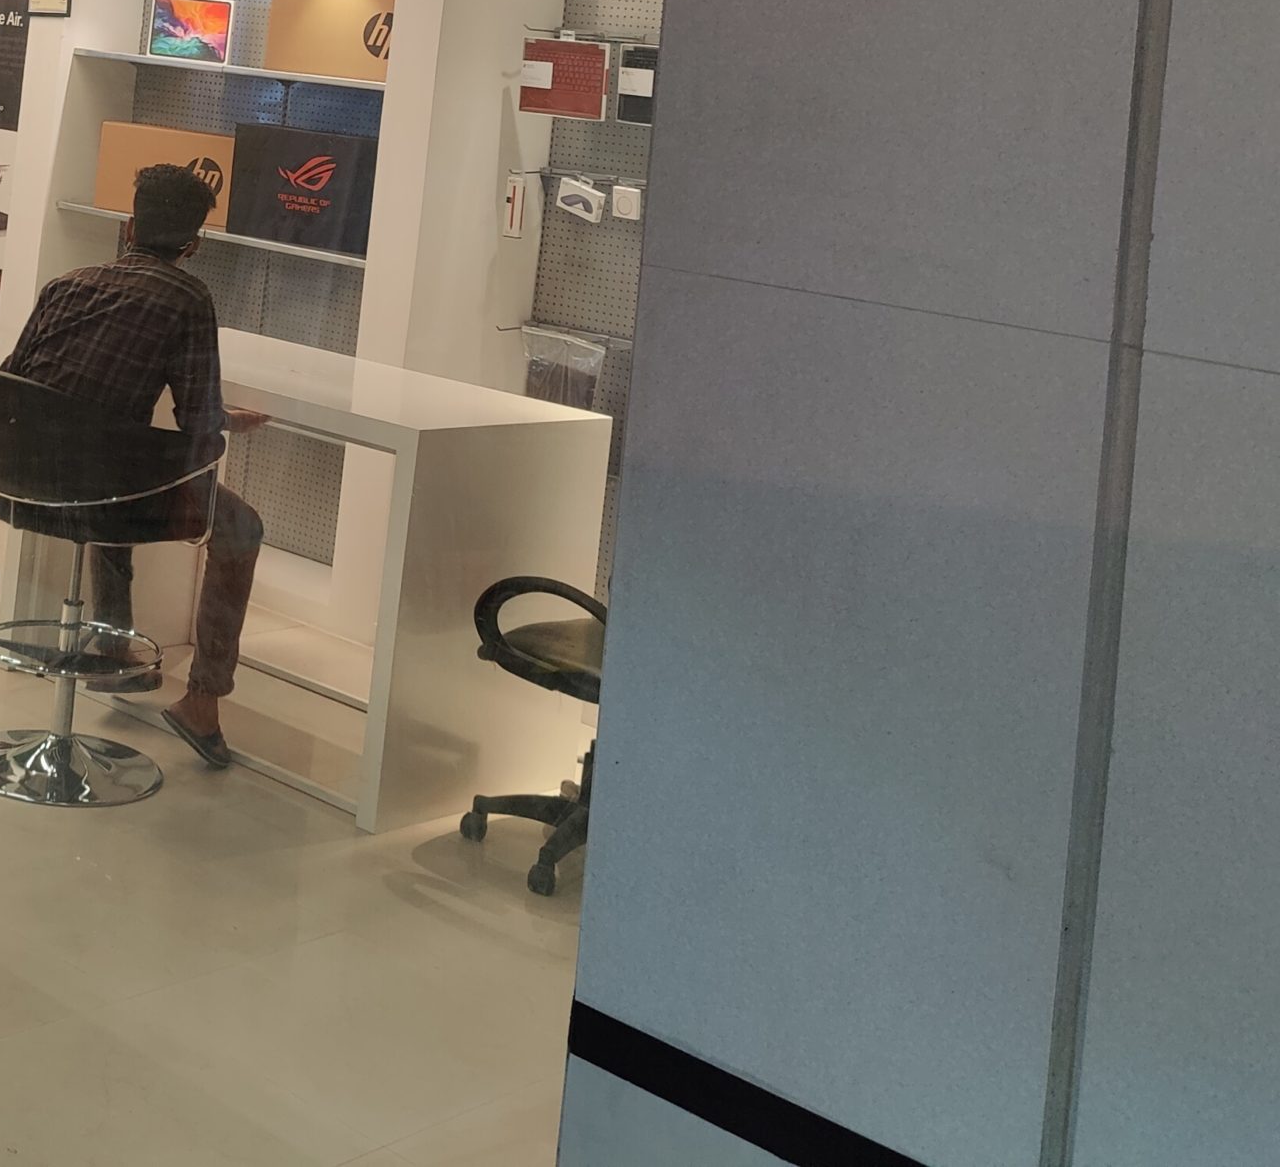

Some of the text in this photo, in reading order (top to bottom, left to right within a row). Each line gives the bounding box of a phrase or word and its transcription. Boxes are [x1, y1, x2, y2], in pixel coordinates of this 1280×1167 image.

[6, 11, 23, 27] Air.
[278, 194, 318, 205] REPUBLIC
[285, 203, 320, 213] GAMERS
